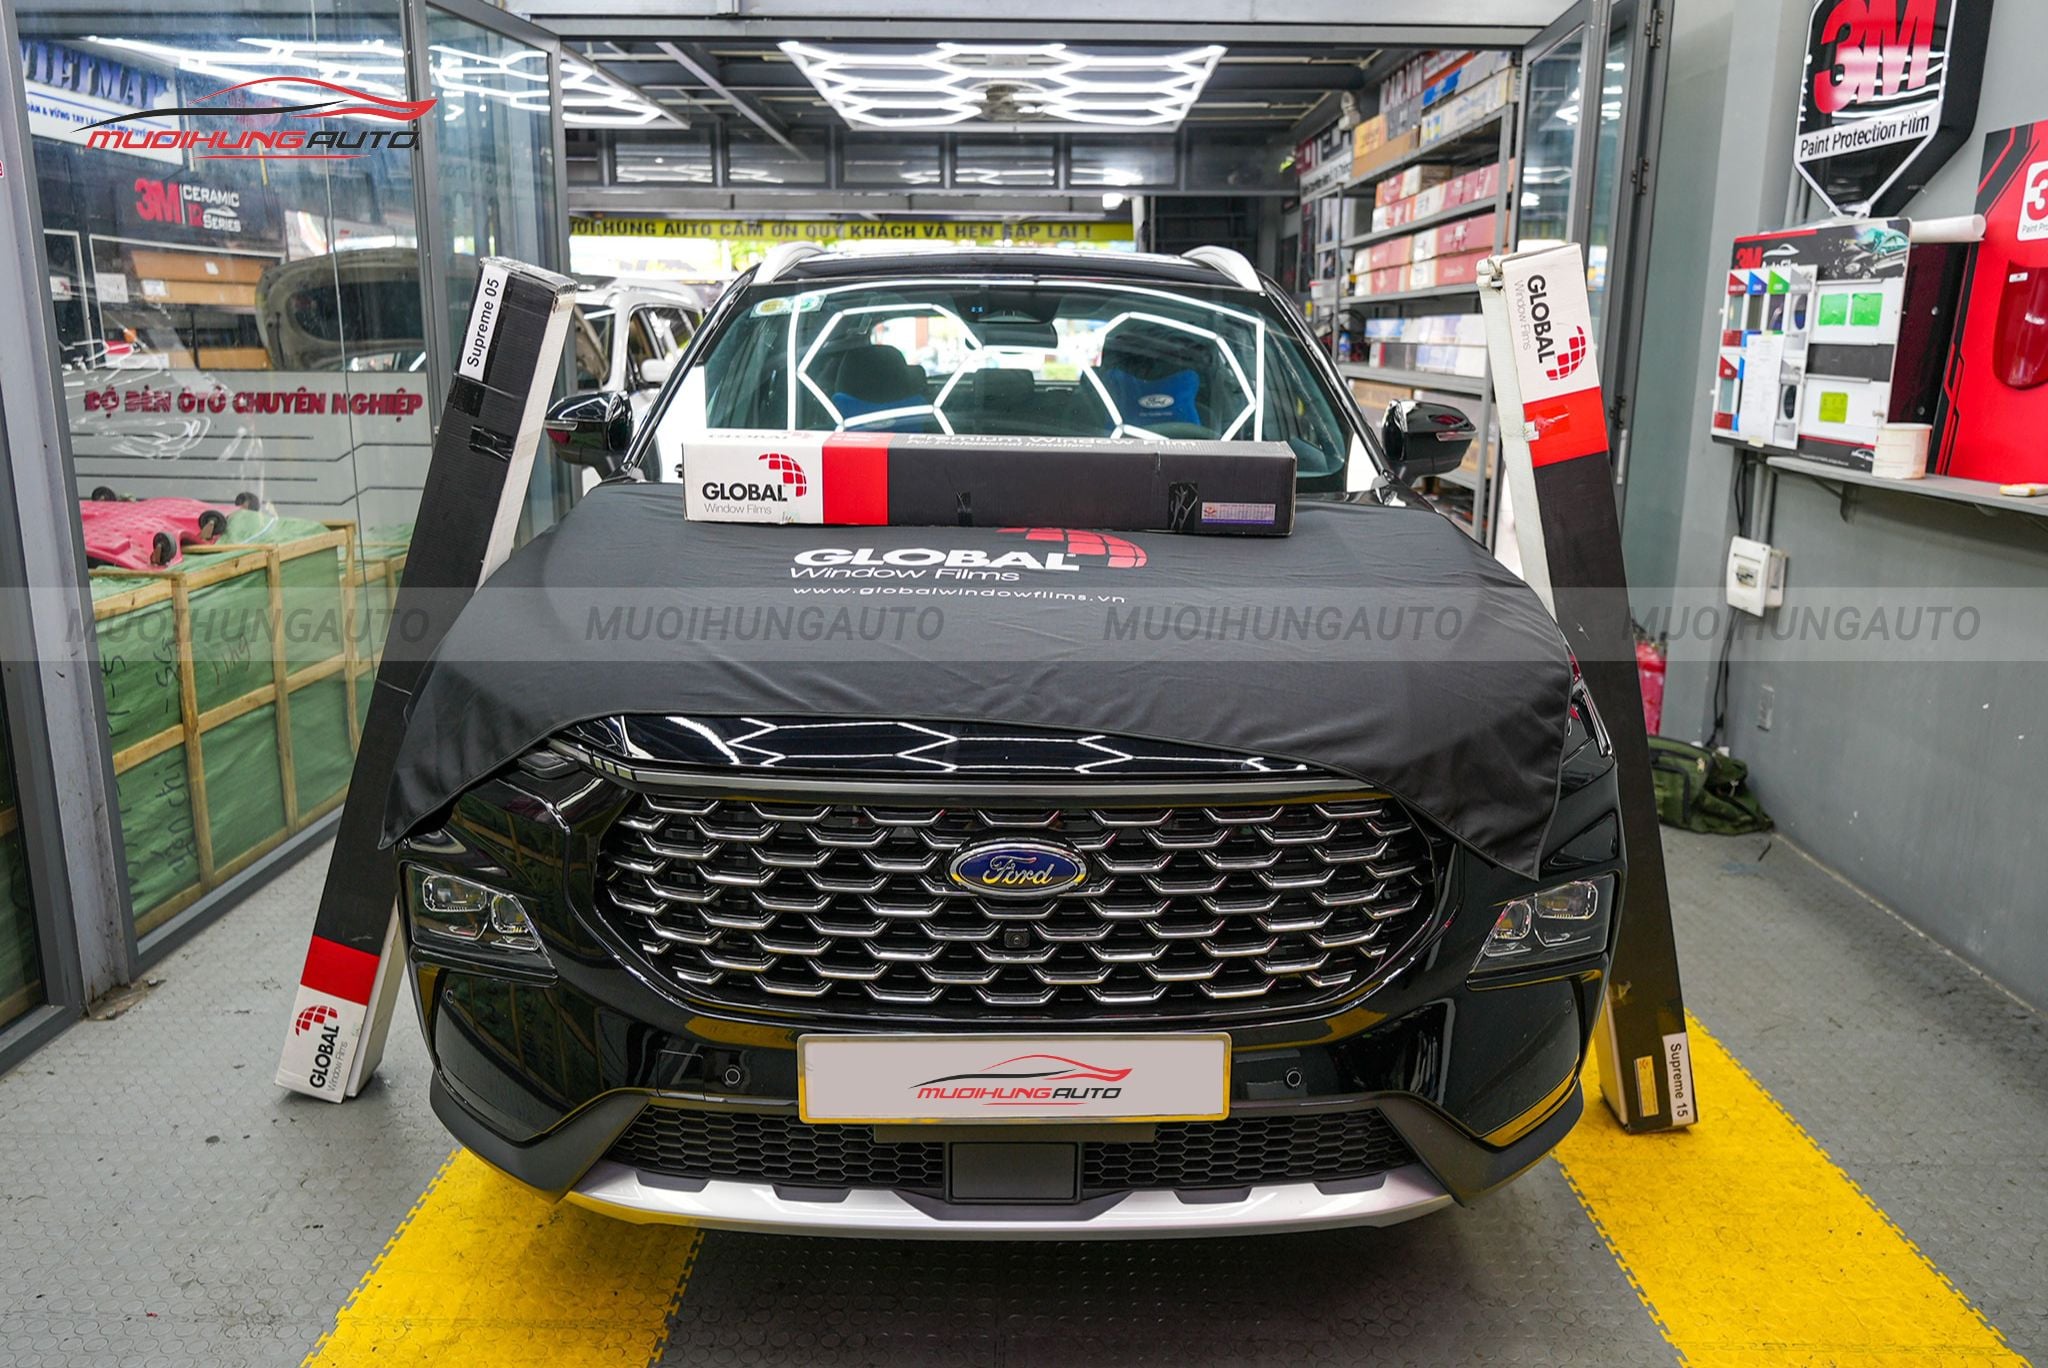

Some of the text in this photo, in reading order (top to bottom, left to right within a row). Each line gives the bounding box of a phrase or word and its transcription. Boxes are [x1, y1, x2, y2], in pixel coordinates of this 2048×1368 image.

[1814, 0, 1938, 114] 3M
[1800, 112, 1930, 158] Paint Protection Film
[134, 177, 182, 224] 3M
[183, 184, 240, 207] CERAMIC
[664, 222, 711, 236] AUTO
[467, 278, 500, 368] Supreme 05
[1514, 280, 1531, 351] Window Films
[1527, 274, 1556, 364] GLOBAL
[232, 386, 326, 414] CHUYÊN
[331, 387, 423, 422] NGHIỆP
[702, 481, 788, 502] GLOBAL
[704, 502, 772, 515] Window Films
[790, 566, 1019, 582] Window Films
[794, 548, 1080, 572] GLOBAL
[793, 585, 1126, 604] www.globalwindowfilms.vn
[982, 855, 1054, 885] Ford
[309, 1025, 340, 1088] GLOBAL
[1669, 1043, 1688, 1117] Supreme 15
